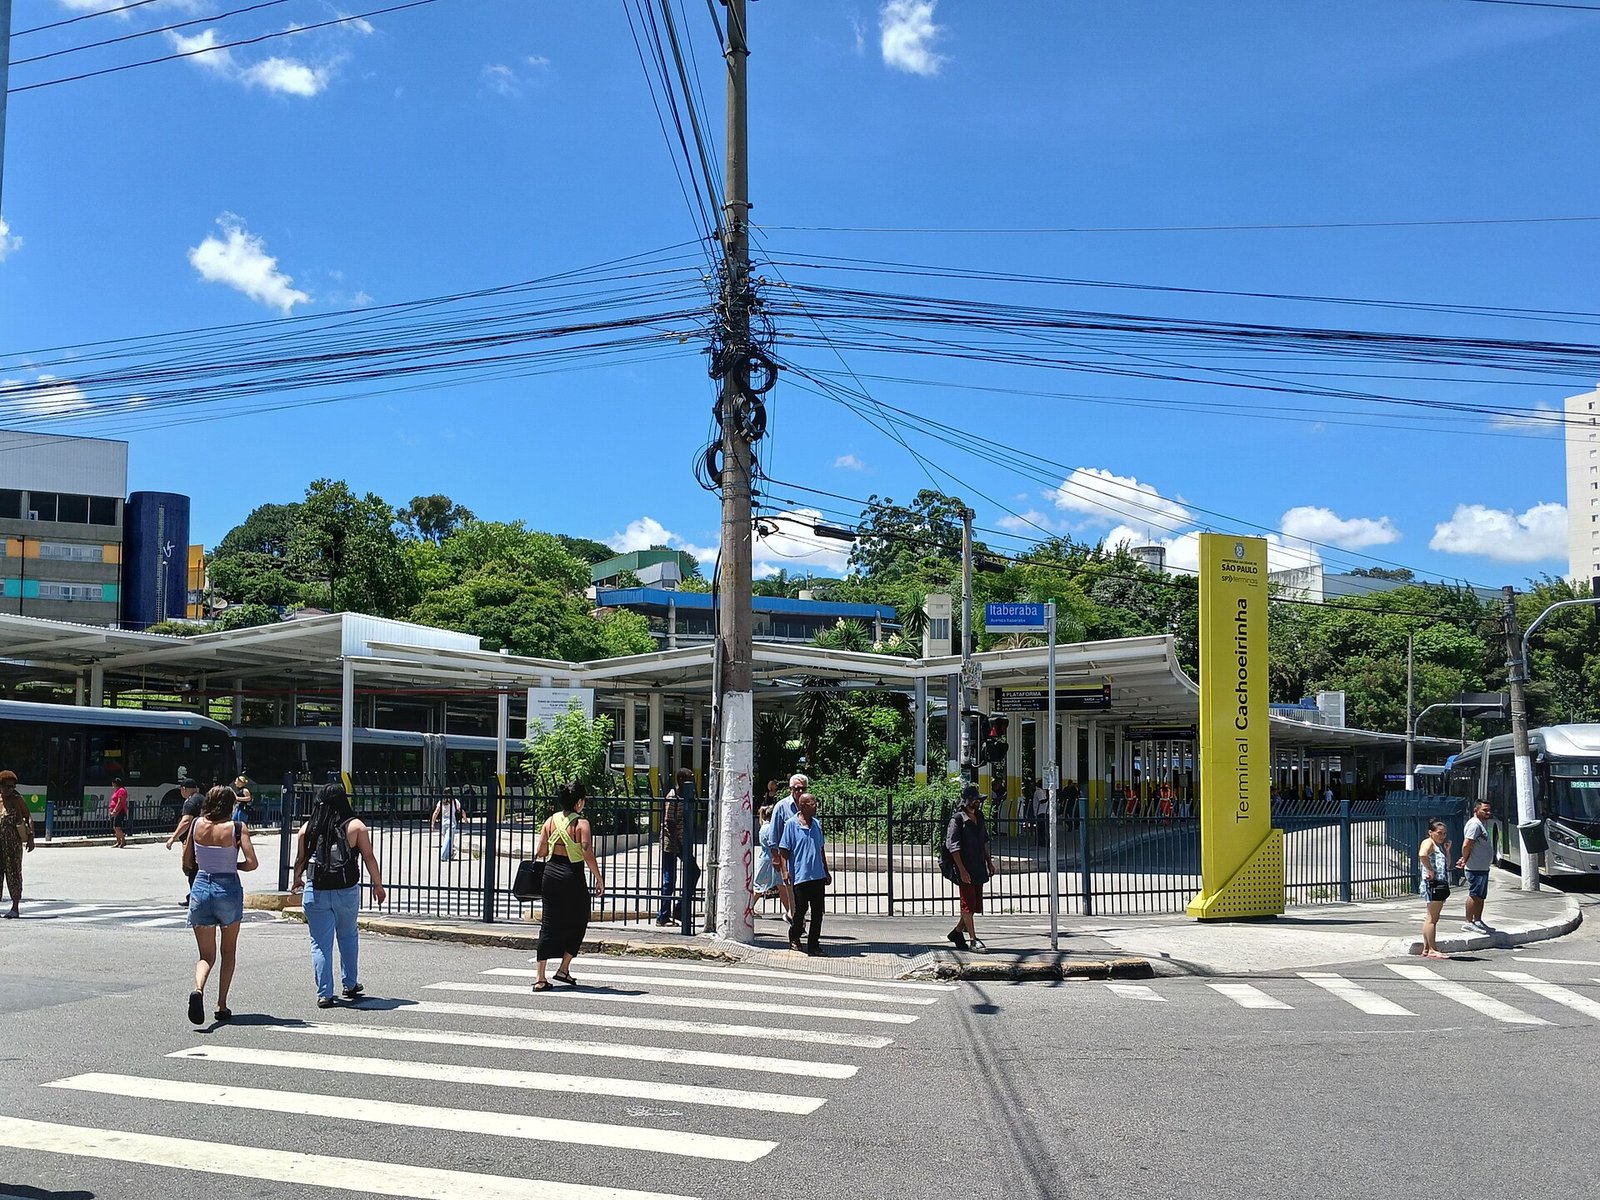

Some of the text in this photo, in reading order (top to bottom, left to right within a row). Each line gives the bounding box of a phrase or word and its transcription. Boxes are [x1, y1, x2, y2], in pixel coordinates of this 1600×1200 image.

[1222, 562, 1258, 574] SÃO PAULO
[990, 604, 1038, 616] Itaberaba
[1234, 598, 1249, 823] Terminal Cachoeirinha
